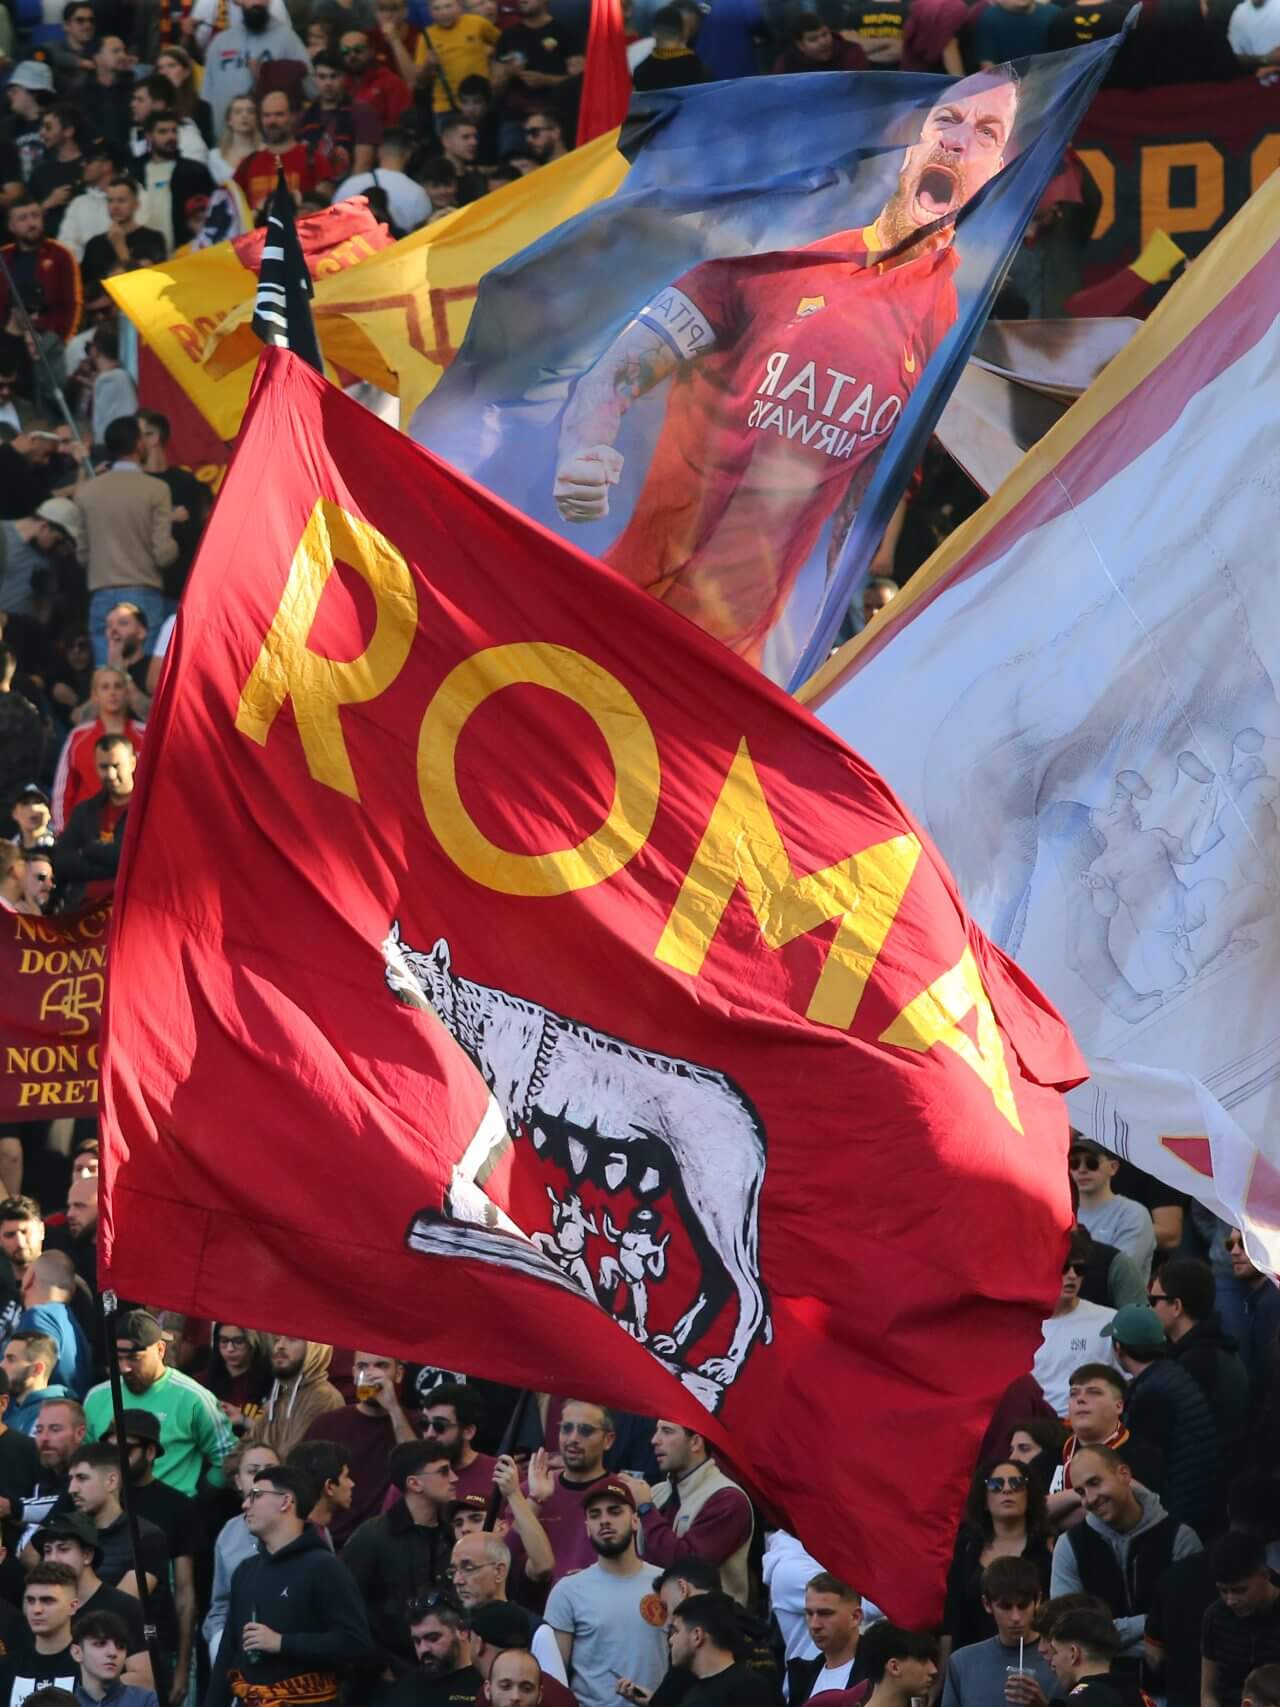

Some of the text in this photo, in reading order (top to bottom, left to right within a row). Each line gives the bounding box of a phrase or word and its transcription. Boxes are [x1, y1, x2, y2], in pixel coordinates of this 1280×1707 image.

[235, 497, 1024, 1136] ROMA
[18, 945, 108, 976] DONN
[6, 1045, 78, 1074] NON
